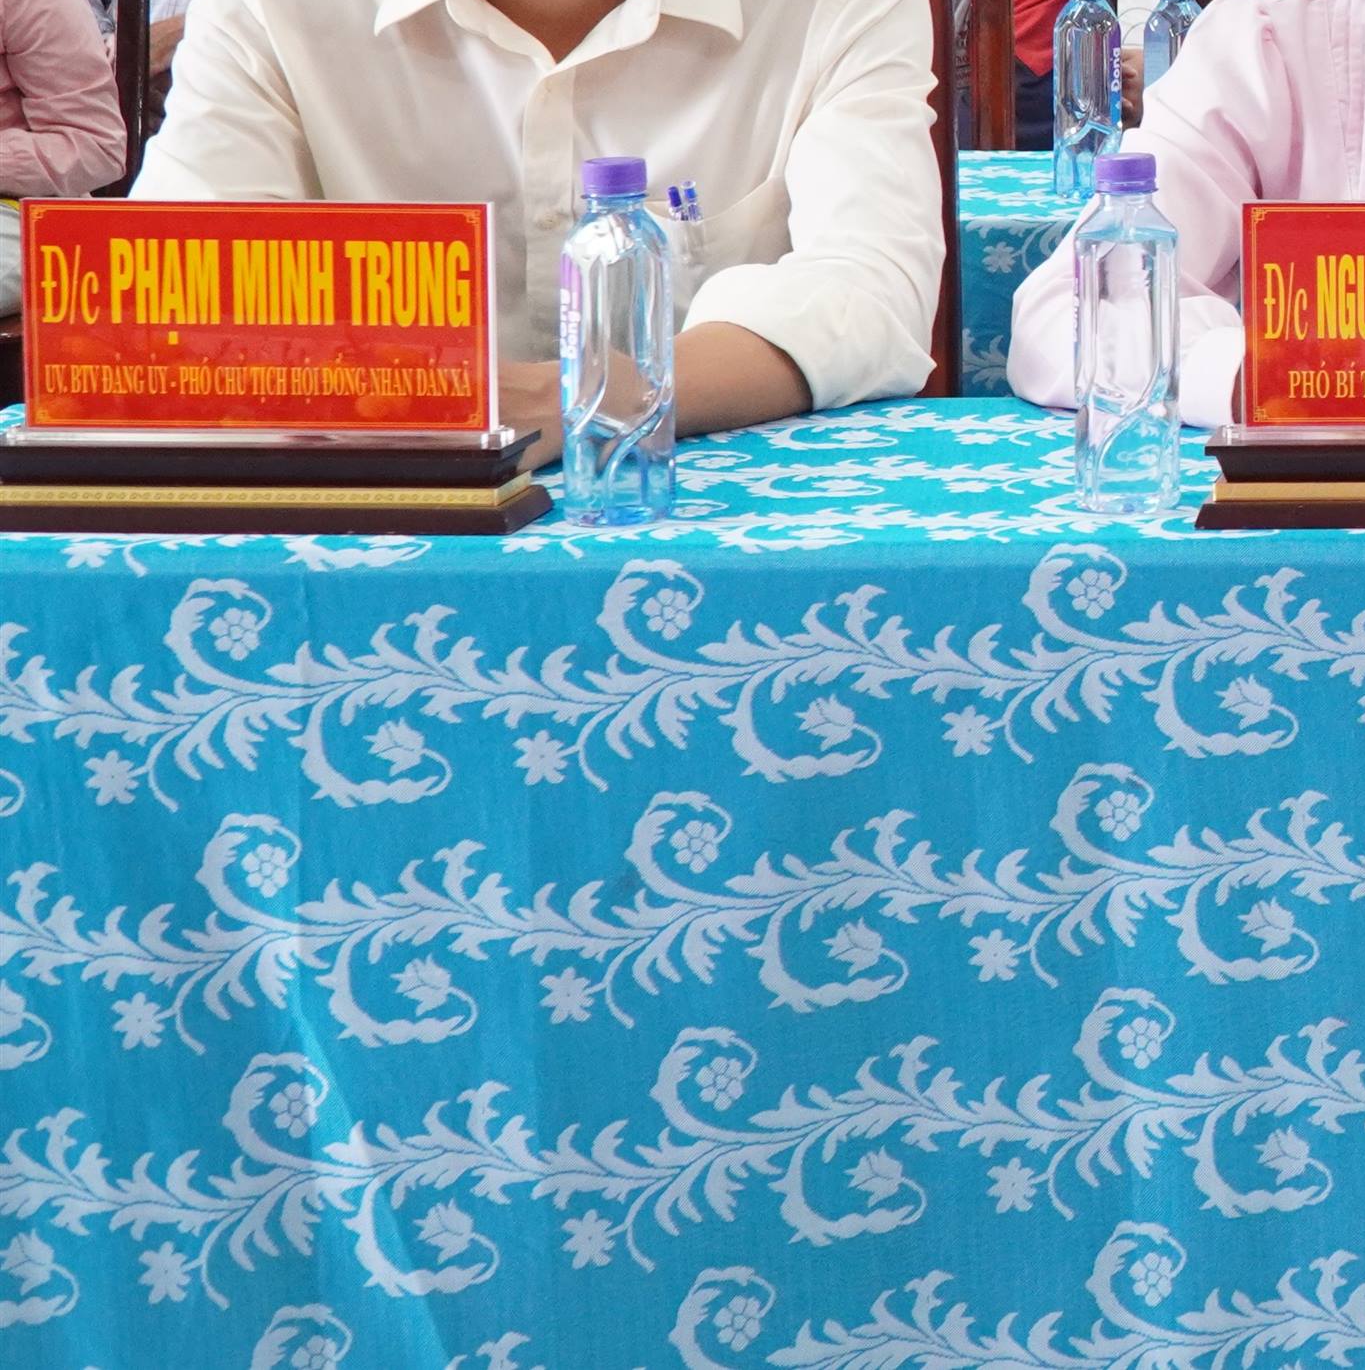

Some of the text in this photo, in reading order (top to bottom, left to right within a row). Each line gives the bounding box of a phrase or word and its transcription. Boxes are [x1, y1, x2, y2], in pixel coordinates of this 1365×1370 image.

[40, 244, 99, 325] Đ/c
[110, 238, 221, 345] PHẠM
[232, 239, 334, 326] MINH
[344, 239, 472, 327] TRUNG
[1263, 262, 1307, 341] Đ/c
[45, 364, 67, 394] UV.
[71, 365, 99, 394] BTV
[102, 352, 144, 395] ĐẢNG
[148, 353, 168, 395] ỦY
[179, 356, 212, 395] PHÓ
[214, 353, 248, 395] CHỦ
[252, 366, 287, 403] TỊCH
[290, 357, 320, 404] HỘI
[322, 352, 367, 396] ĐỒNG
[1288, 361, 1330, 399] PHÓ
[1335, 361, 1356, 399] BÍ
